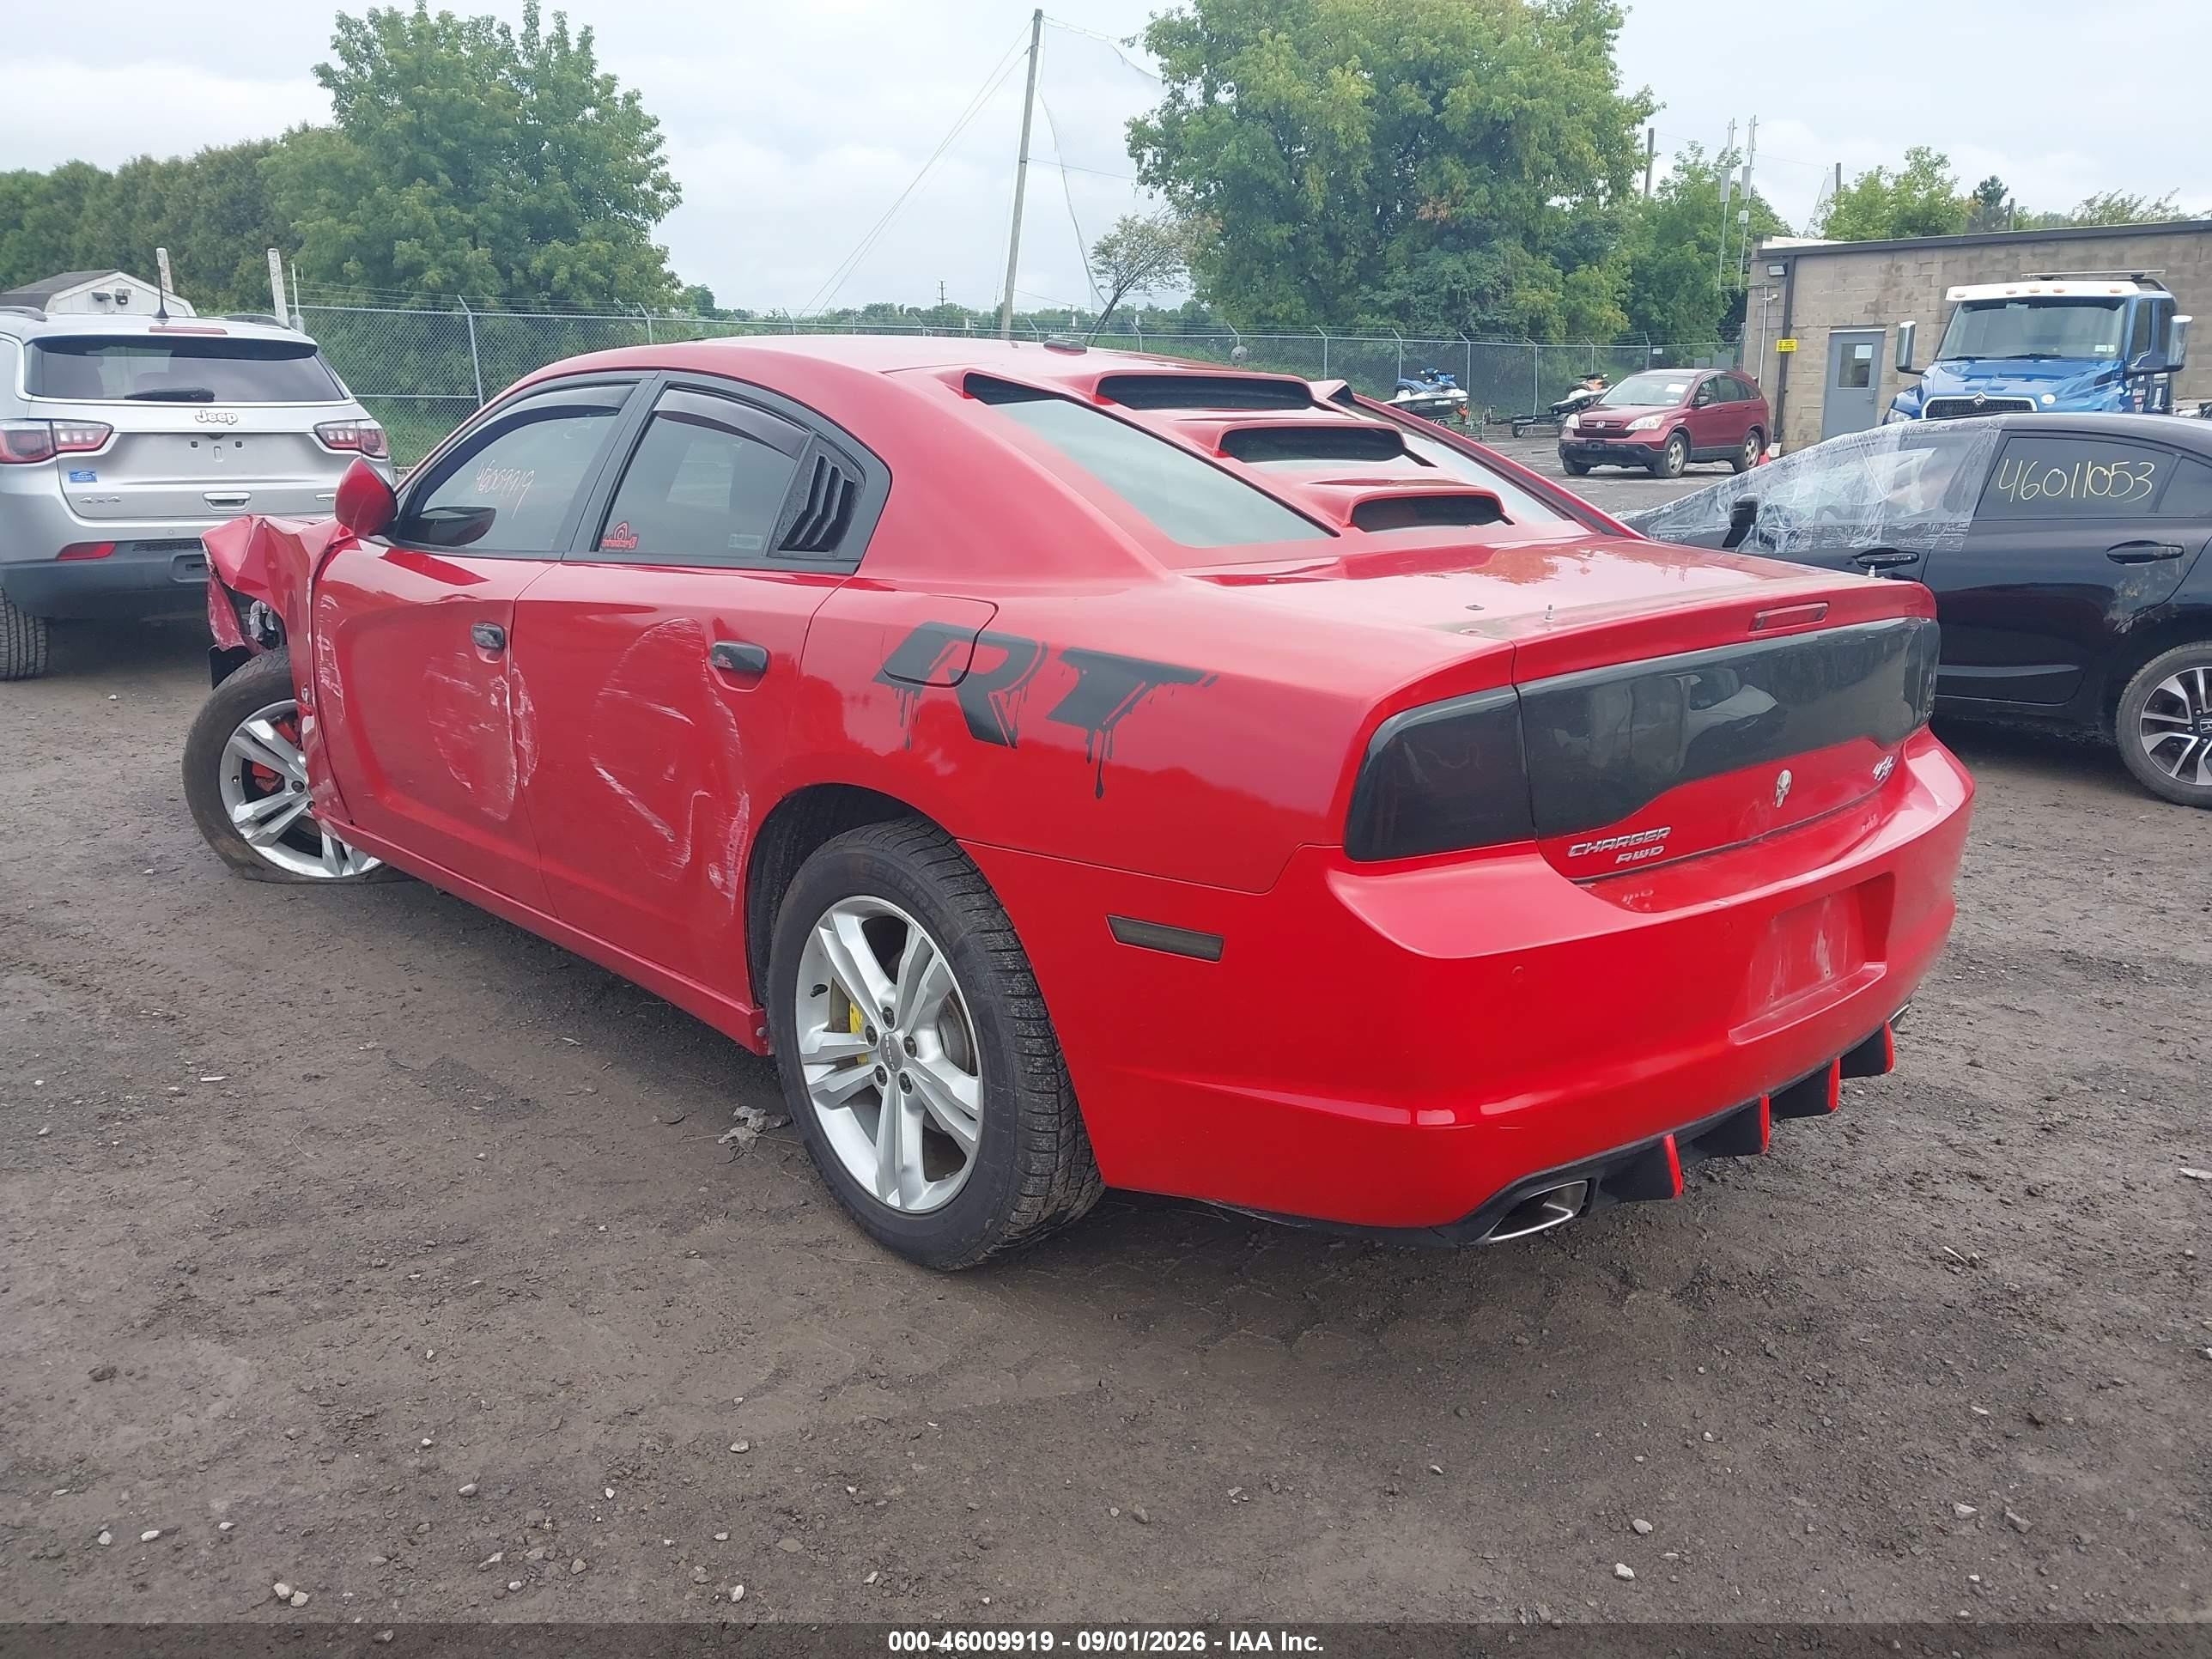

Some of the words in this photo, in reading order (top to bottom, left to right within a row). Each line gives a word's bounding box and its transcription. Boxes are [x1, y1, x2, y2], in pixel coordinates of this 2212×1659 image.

[194, 410, 239, 426] Jeep
[1998, 458, 2155, 504] 46011053
[1568, 826, 1671, 858] CHARGER
[1615, 845, 1665, 864] AWD
